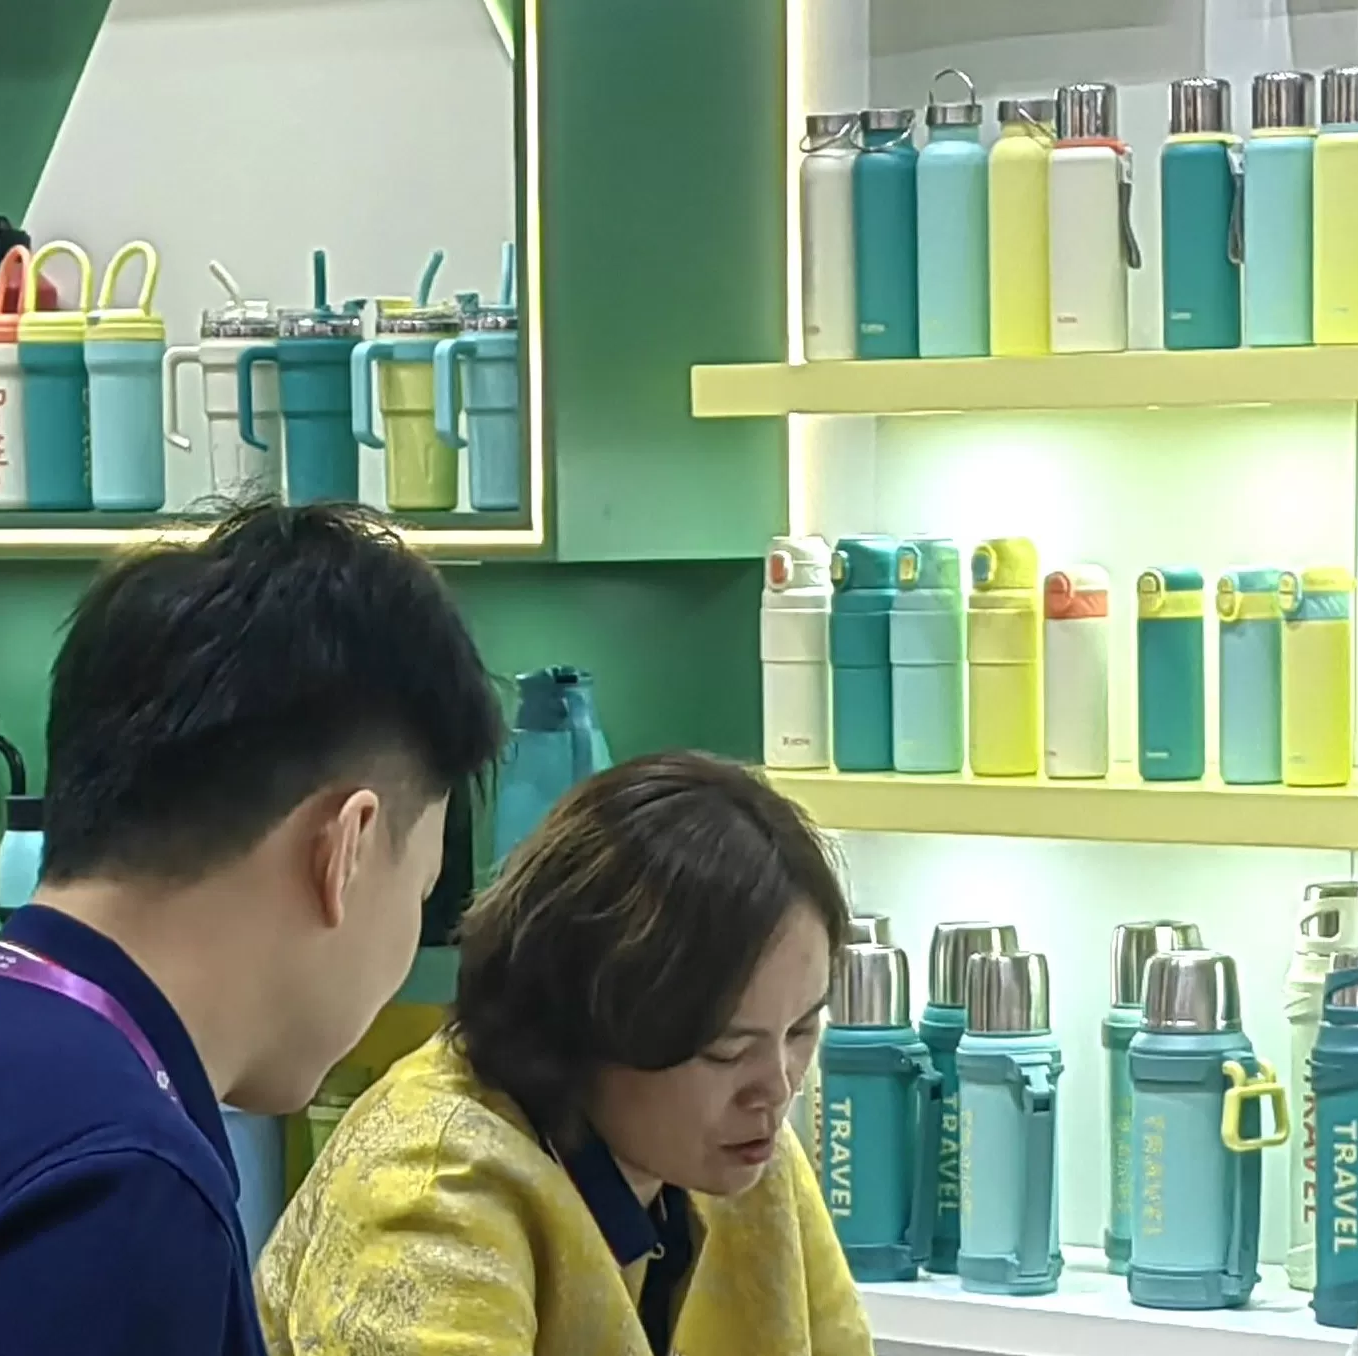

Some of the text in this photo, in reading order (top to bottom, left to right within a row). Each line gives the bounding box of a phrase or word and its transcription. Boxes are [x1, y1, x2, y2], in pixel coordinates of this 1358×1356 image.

[829, 1096, 852, 1219] TRAVEL
[938, 1092, 959, 1217] TRAVEL
[1333, 1119, 1358, 1255] TRAVEL
